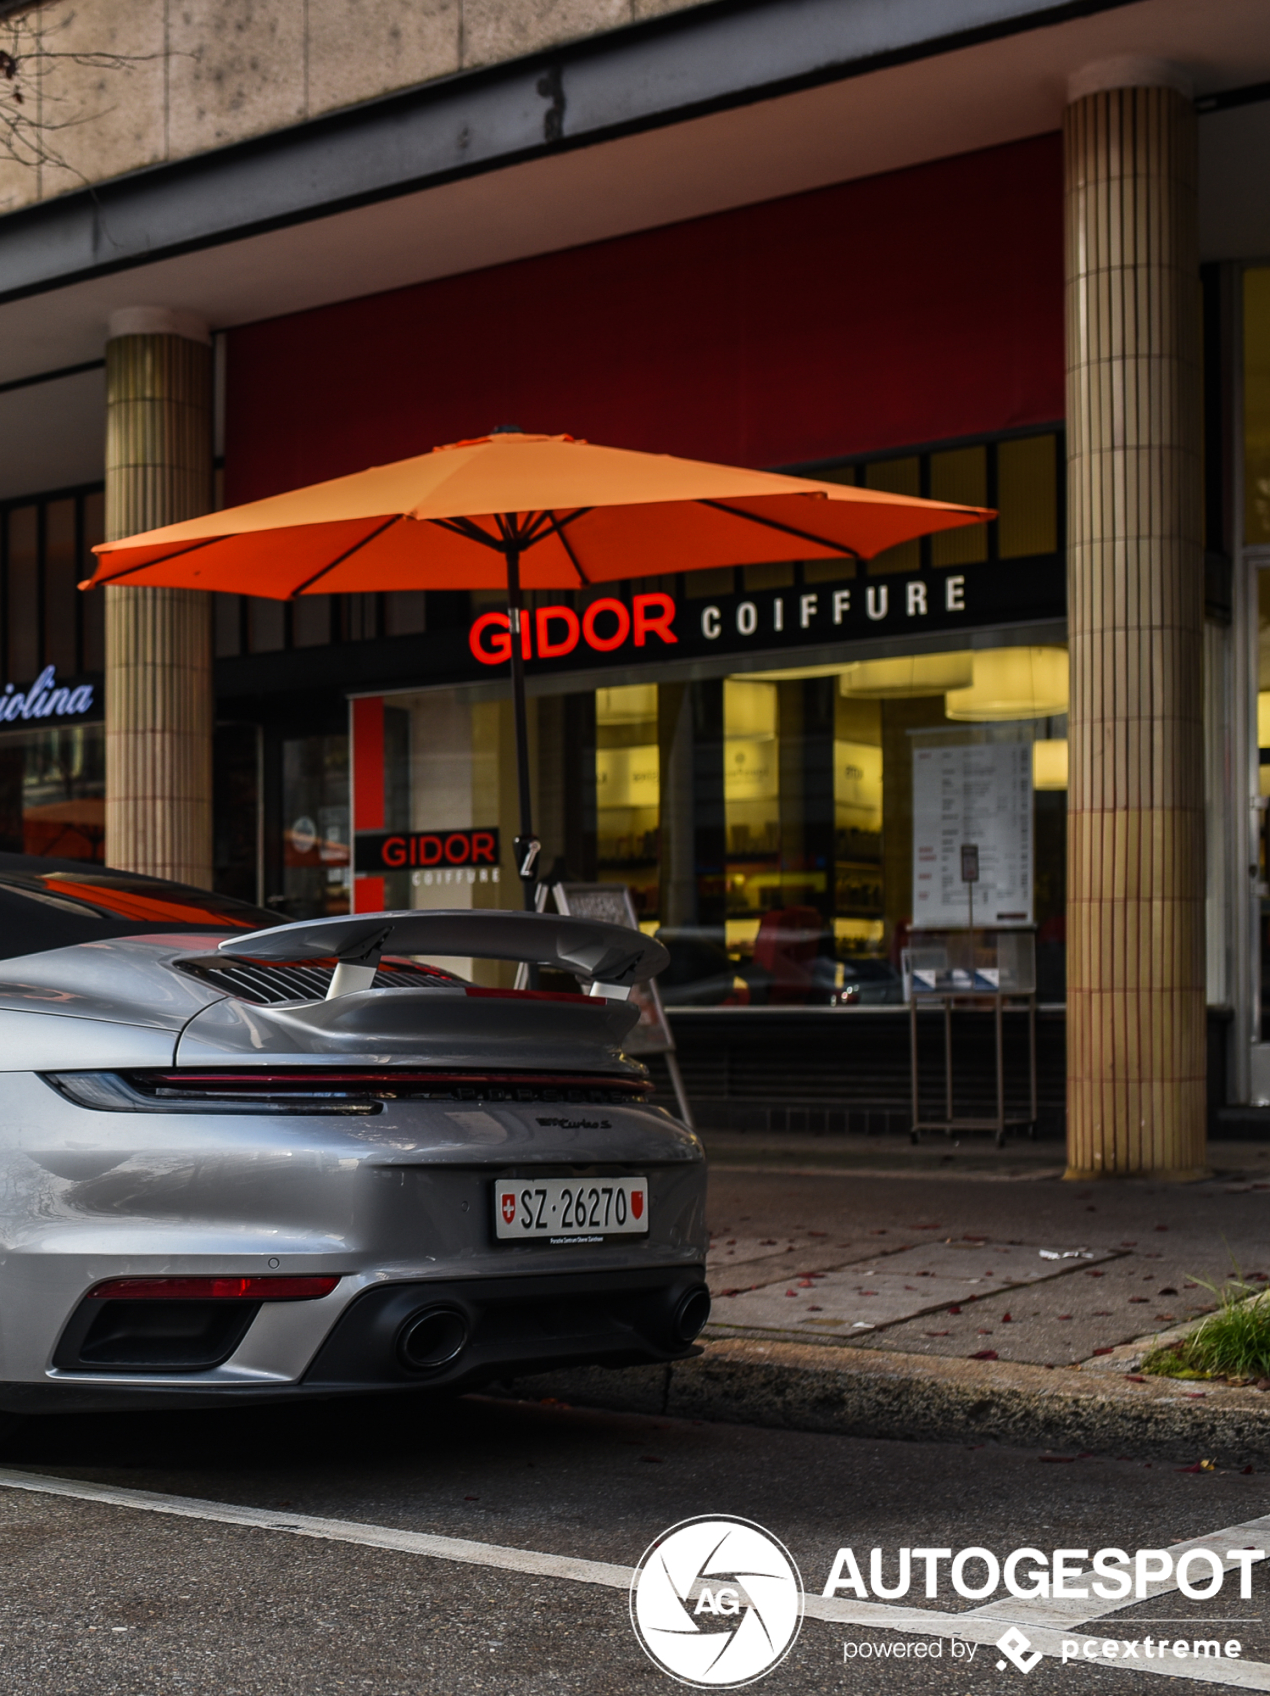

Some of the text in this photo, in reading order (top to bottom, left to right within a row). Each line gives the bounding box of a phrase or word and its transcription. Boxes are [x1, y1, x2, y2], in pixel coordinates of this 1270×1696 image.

[469, 575, 966, 665] GIDOR COIFFURE
[381, 832, 495, 867] GIDOR
[412, 868, 500, 887] COIFFURE
